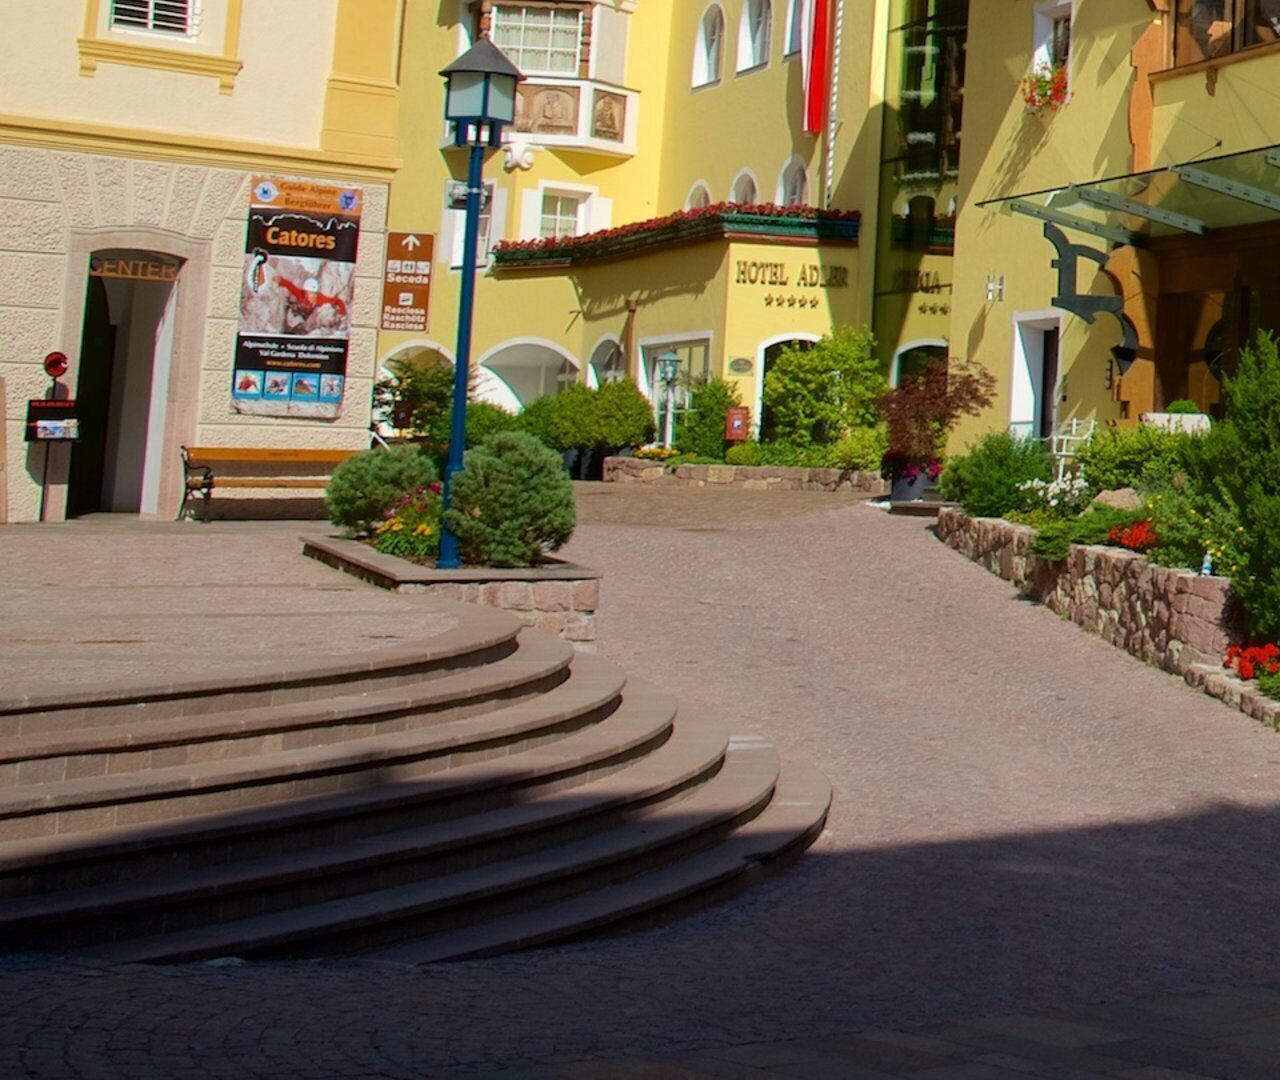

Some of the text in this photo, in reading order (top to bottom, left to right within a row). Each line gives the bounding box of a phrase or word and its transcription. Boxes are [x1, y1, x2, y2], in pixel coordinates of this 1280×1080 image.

[266, 226, 336, 250] Catores
[91, 257, 177, 279] CENTER
[386, 273, 429, 284] Seceda
[735, 260, 849, 288] HOTEL ADLER
